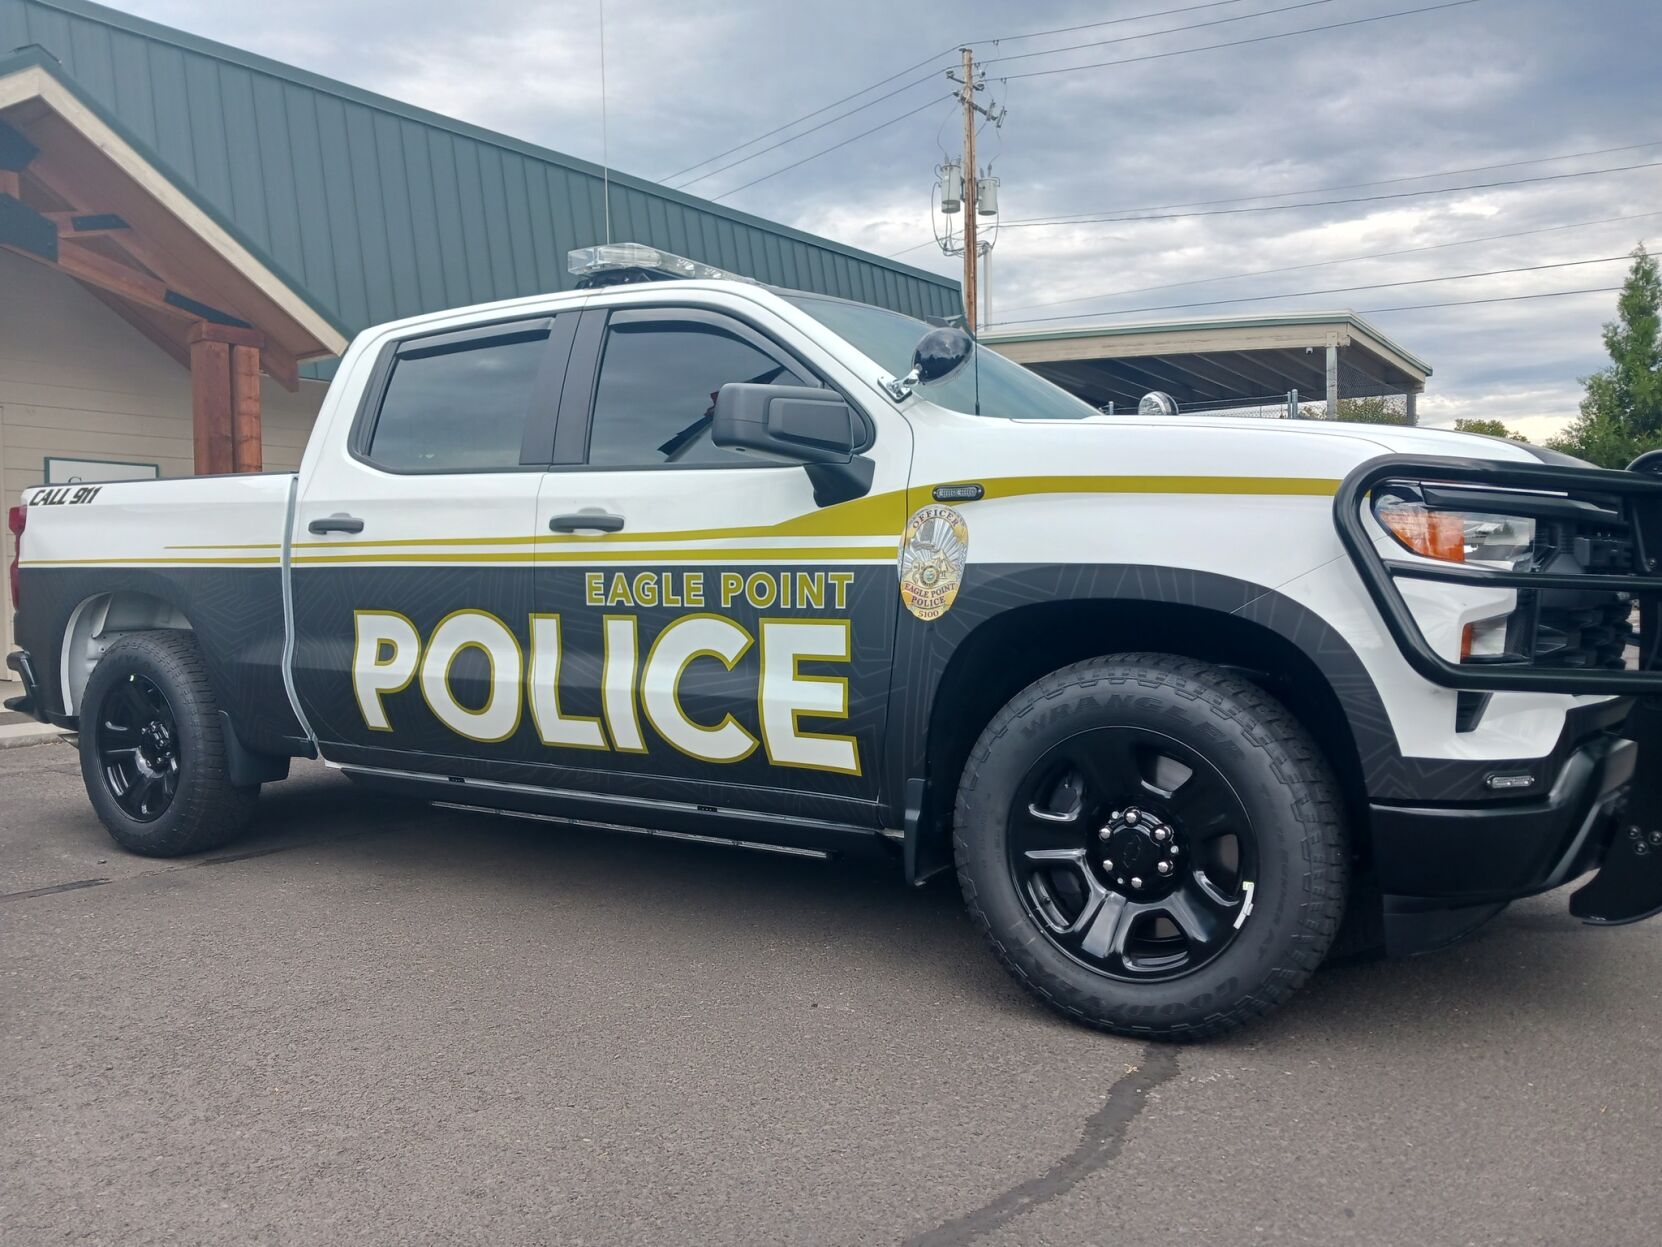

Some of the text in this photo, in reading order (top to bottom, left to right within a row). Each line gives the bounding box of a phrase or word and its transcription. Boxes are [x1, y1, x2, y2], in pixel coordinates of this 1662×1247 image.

[29, 486, 103, 506] CALL 911
[912, 508, 960, 530] OFFICER
[585, 571, 855, 610] EAGLE POINT
[904, 582, 956, 599] EAGLE POINT
[911, 595, 946, 608] POLICE
[917, 610, 939, 618] 5100
[352, 607, 863, 777] POLICE
[1020, 693, 1247, 761] WRANGLER
